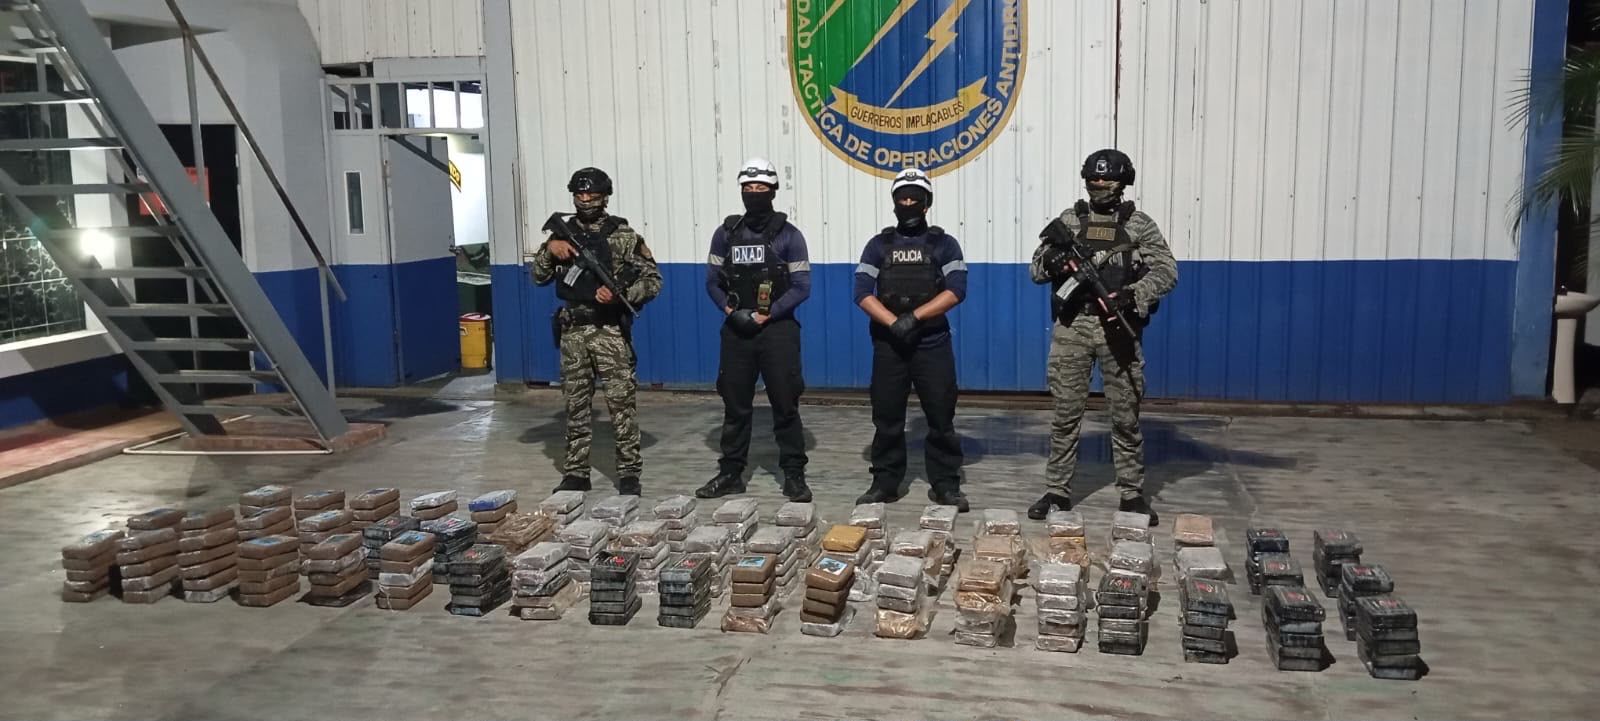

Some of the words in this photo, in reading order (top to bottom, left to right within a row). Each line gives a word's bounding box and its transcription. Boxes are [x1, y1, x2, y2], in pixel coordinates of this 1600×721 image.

[799, 54, 843, 143] TACTICA
[844, 135, 872, 160] DE
[874, 98, 1002, 169] OPERACIONES
[996, 0, 1019, 98] ANTIDR
[851, 106, 901, 129] GUERREROS
[906, 103, 965, 129] IMPLACABLES
[892, 250, 923, 262] POLICIA
